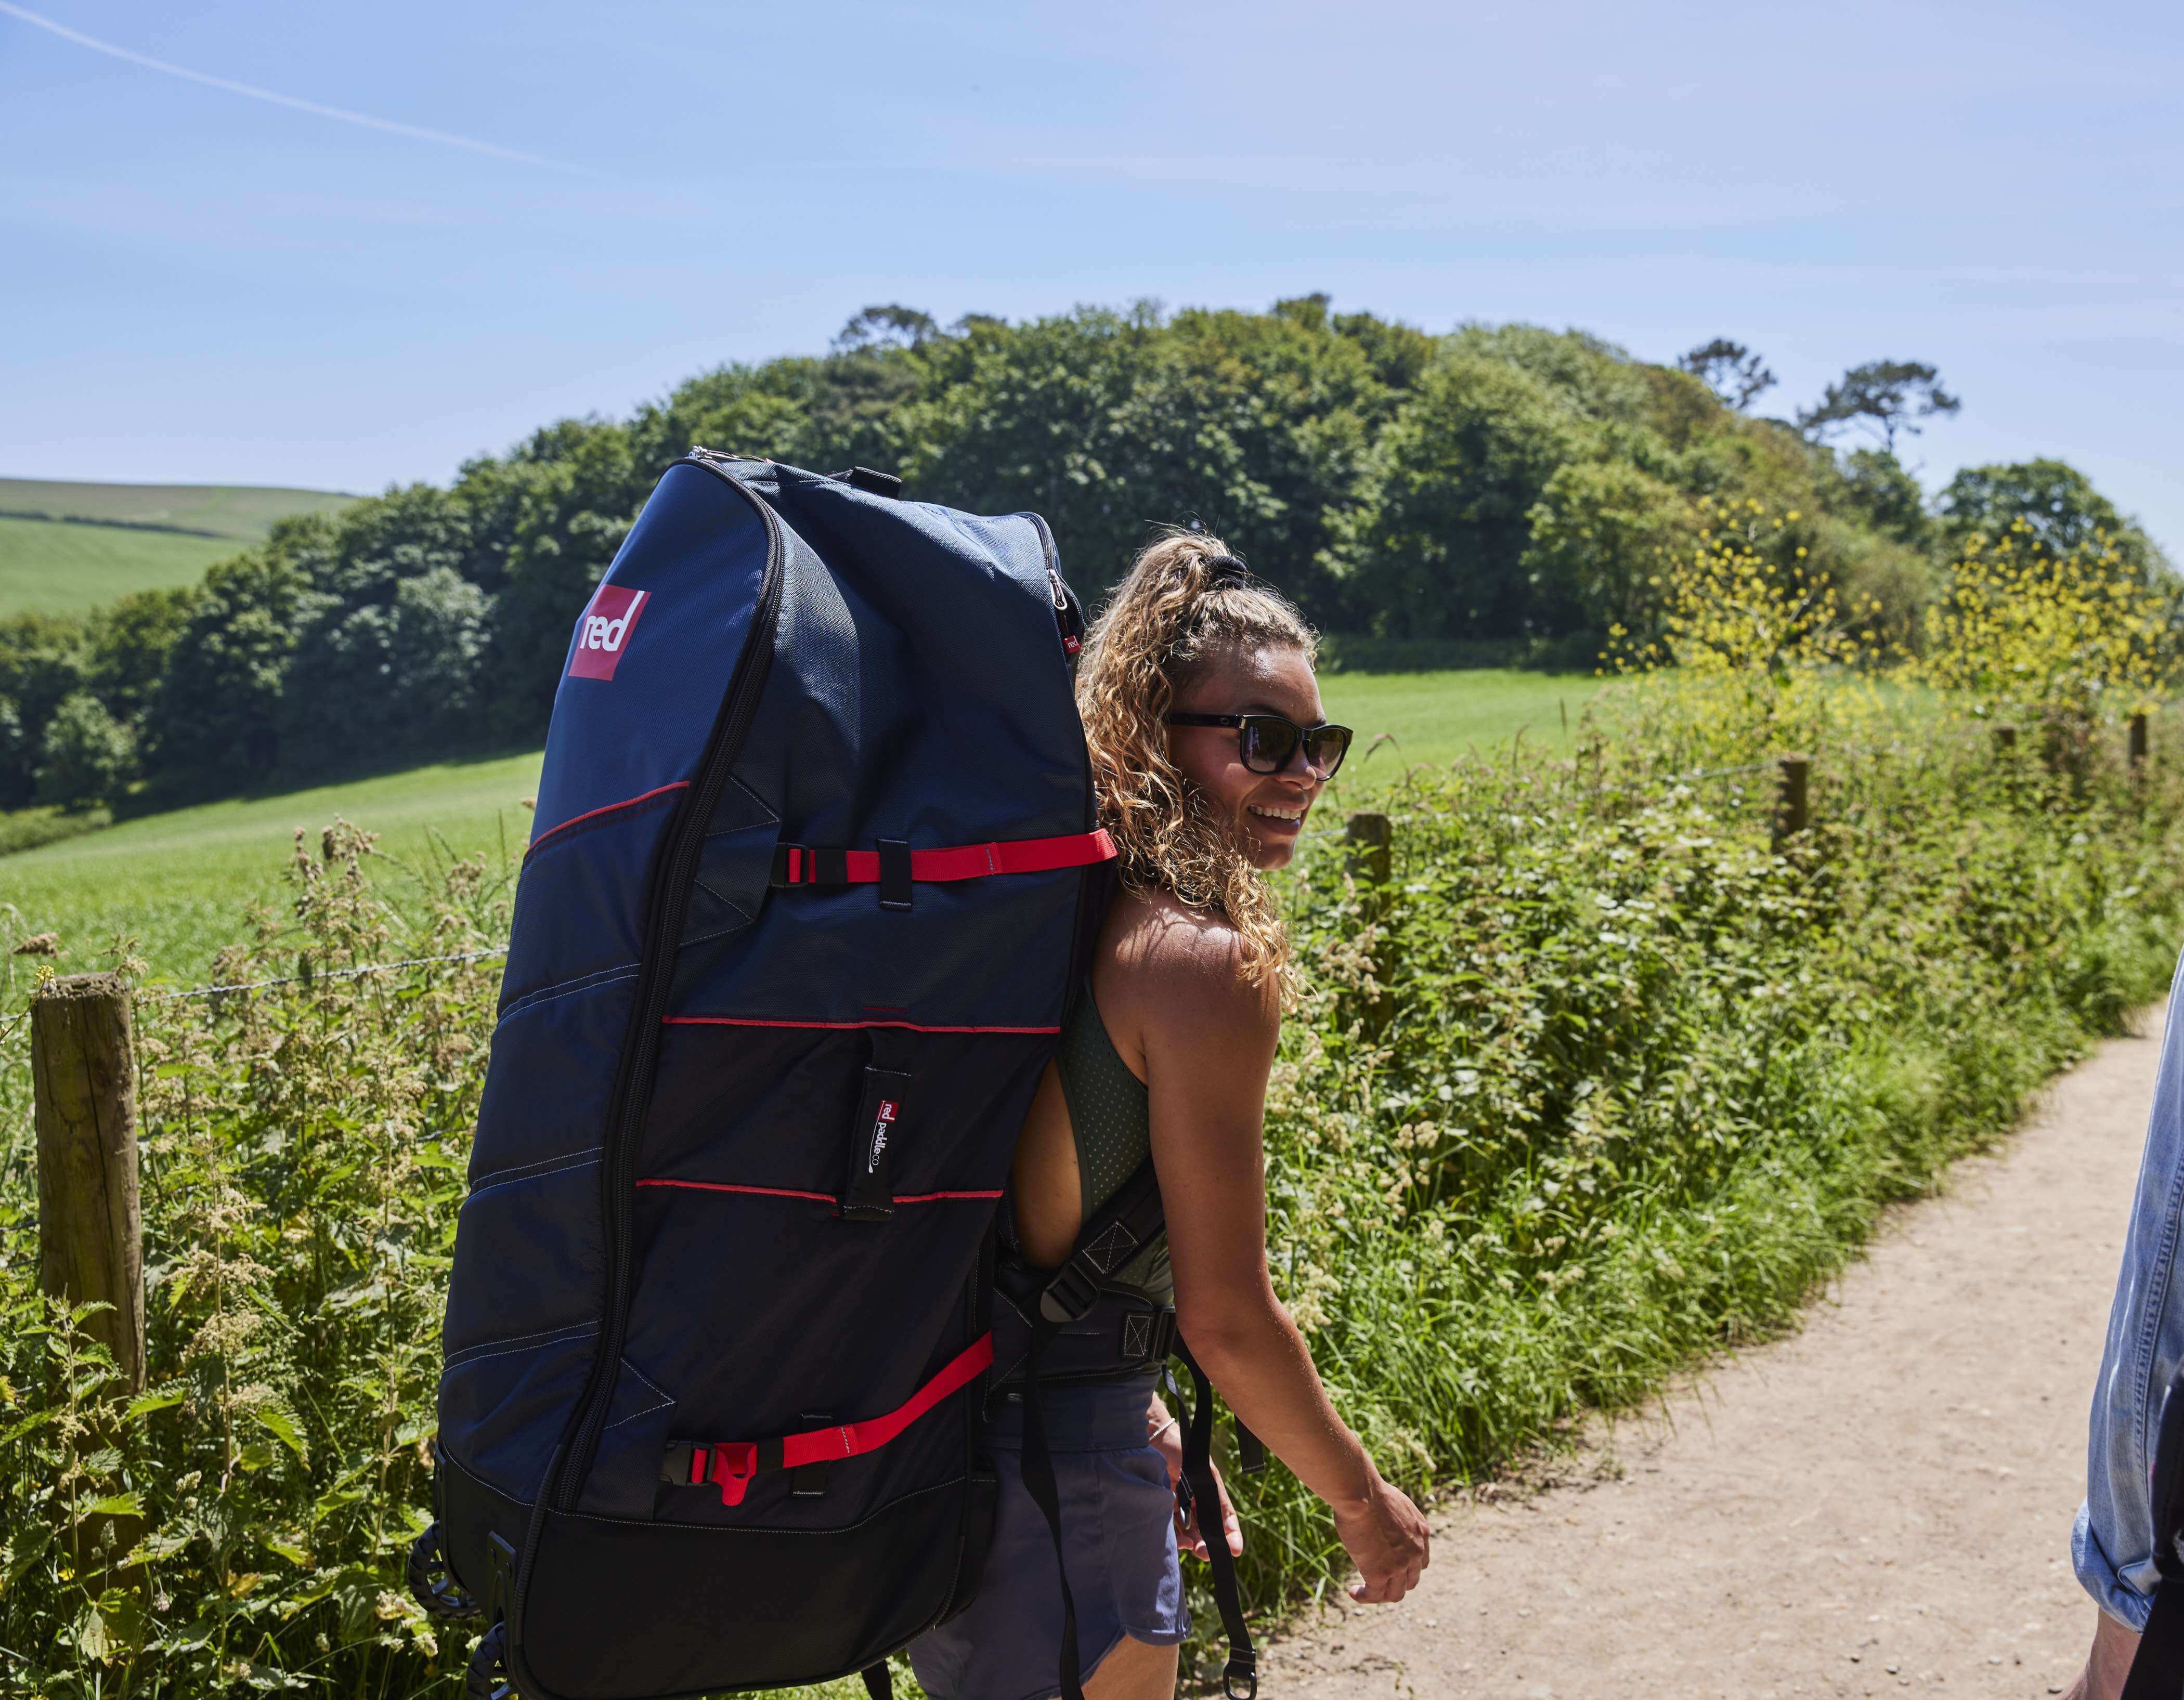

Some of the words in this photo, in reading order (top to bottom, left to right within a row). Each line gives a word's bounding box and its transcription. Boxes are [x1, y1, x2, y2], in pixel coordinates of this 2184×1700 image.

[580, 590, 645, 651] red
[1068, 635, 1078, 649] red
[881, 1104, 895, 1120] red
